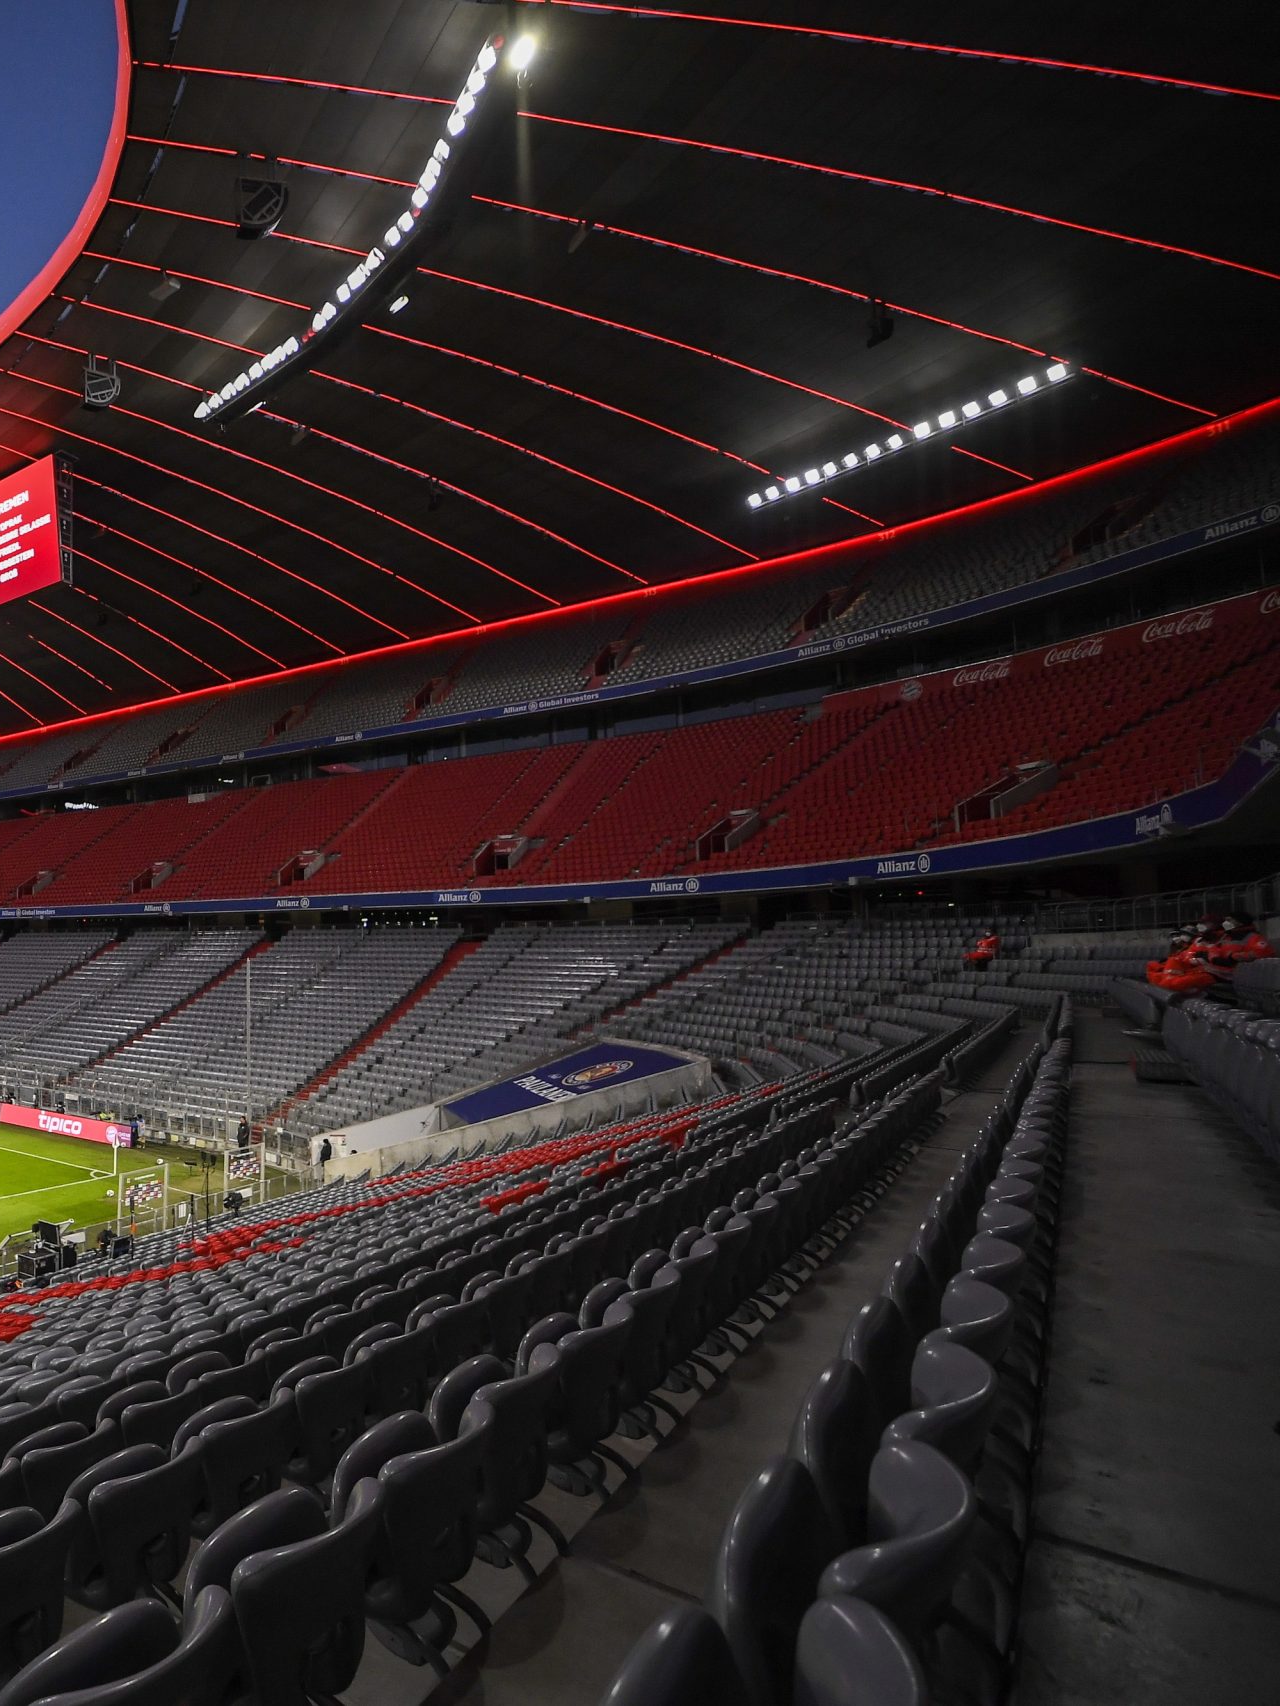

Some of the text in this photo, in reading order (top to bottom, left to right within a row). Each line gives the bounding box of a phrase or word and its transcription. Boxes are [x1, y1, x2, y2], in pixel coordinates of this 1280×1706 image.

[1205, 516, 1258, 540] Allianz
[797, 618, 929, 657] Allianz Global Investors
[503, 693, 599, 714] Allianz Global Investors
[877, 860, 916, 874] Allianz
[650, 882, 684, 893] Allianz
[276, 899, 299, 908] Allianz
[438, 893, 468, 902] Allianz
[38, 1110, 82, 1135] tipico
